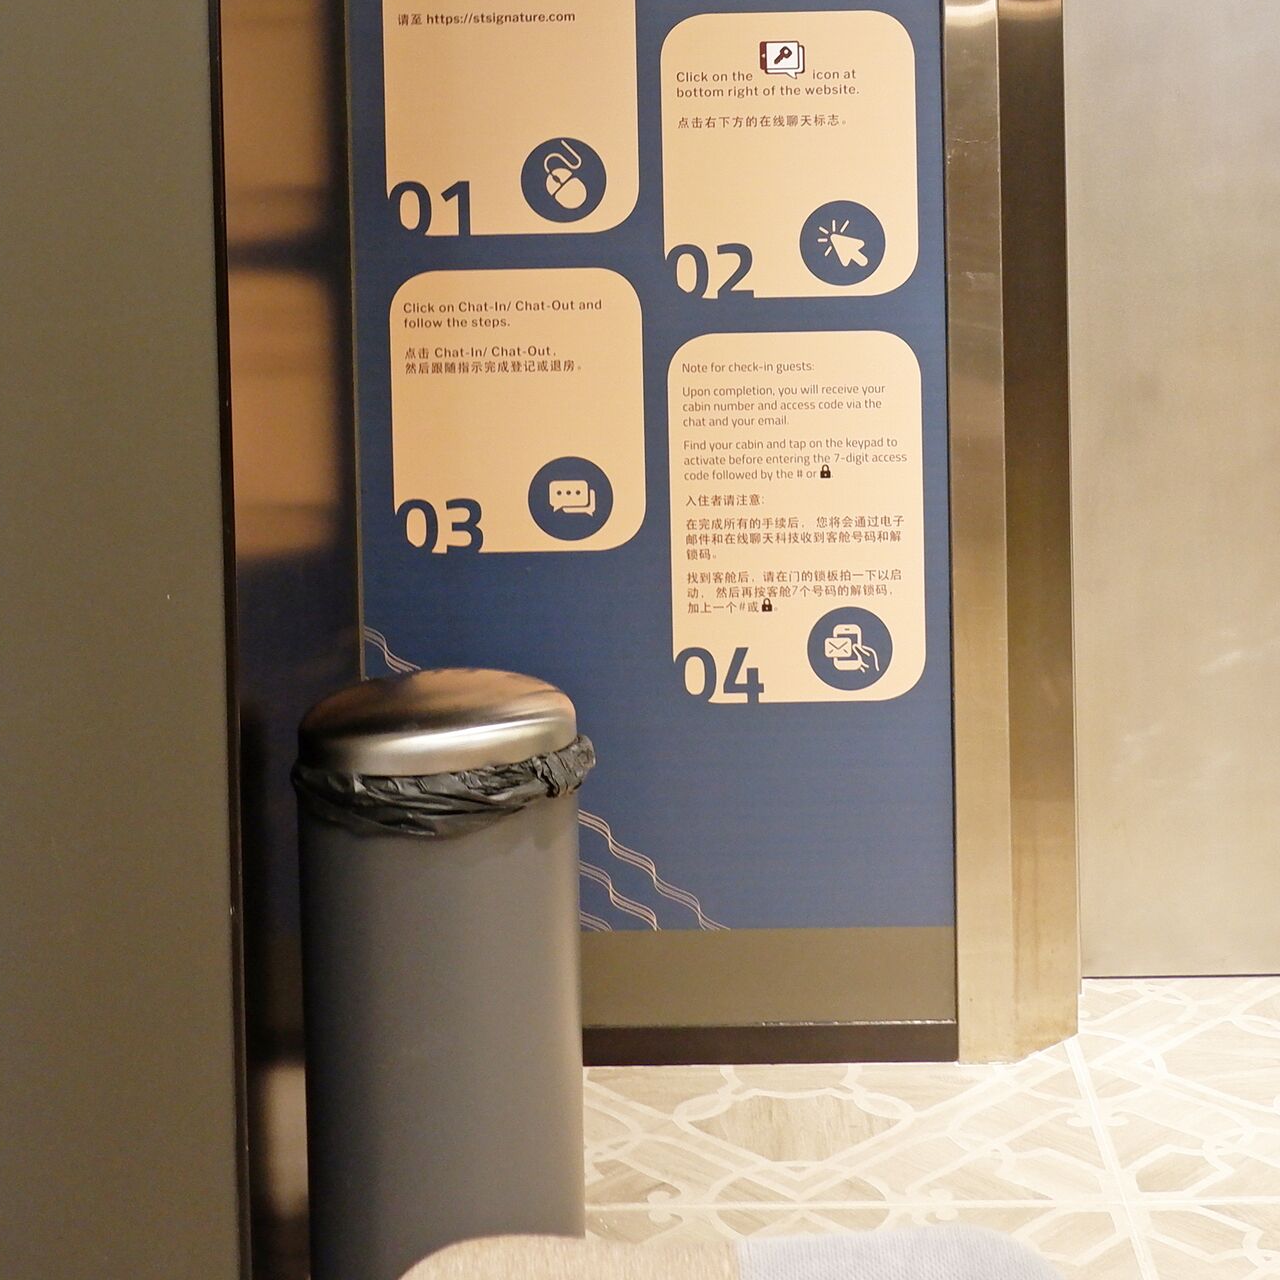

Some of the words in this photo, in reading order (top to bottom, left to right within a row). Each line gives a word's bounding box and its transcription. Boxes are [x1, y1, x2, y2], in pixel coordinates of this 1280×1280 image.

[426, 12, 575, 26] https://stsignature.com
[676, 71, 708, 83] Click
[712, 71, 728, 82] on
[732, 71, 753, 81] the
[812, 69, 839, 80] icon
[843, 69, 856, 80] at
[676, 86, 724, 98] bottom
[728, 86, 759, 98] right
[762, 85, 776, 96] of
[780, 85, 801, 96] the
[804, 84, 860, 96] website.
[388, 180, 471, 236] 01
[666, 243, 754, 299] 02
[403, 302, 435, 314] Click
[439, 302, 455, 313] on
[458, 301, 511, 312] Chat-In/
[515, 300, 575, 312] Chat-Out
[578, 299, 602, 311] and
[403, 317, 443, 329] follow
[447, 317, 467, 328] the
[471, 317, 510, 329] steps.
[434, 346, 488, 358] Chat-In/
[682, 362, 708, 373] Note
[710, 362, 725, 373] for
[728, 361, 774, 372] check-in
[776, 361, 815, 374] guests:
[682, 386, 710, 398] Upon
[713, 385, 776, 398] completion,
[778, 386, 798, 398] you
[800, 384, 819, 394] will
[821, 384, 859, 394] receive
[862, 385, 885, 396] your
[682, 400, 711, 412] cabin
[713, 400, 755, 411] number
[757, 400, 778, 411] and
[780, 401, 816, 410] access
[818, 399, 844, 410] code
[846, 399, 861, 410] via
[864, 399, 882, 409] the
[682, 416, 706, 427] chat
[709, 416, 729, 427] and
[731, 417, 755, 428] your
[757, 416, 789, 426] email.
[683, 440, 707, 451] Find
[709, 440, 733, 452] your
[735, 439, 763, 450] cabin
[766, 439, 786, 449] and
[789, 439, 806, 451] tap
[809, 439, 823, 449] on
[825, 438, 843, 448] the
[845, 437, 884, 449] keypad
[886, 437, 898, 448] to
[683, 454, 726, 466] activate
[728, 454, 763, 465] before
[766, 453, 810, 466] entering
[813, 453, 831, 463] the
[834, 452, 869, 464] 7-digit
[871, 453, 908, 463] access
[683, 469, 709, 481] code
[711, 469, 758, 480] followed
[760, 469, 774, 482] by
[776, 469, 794, 479] the
[806, 469, 817, 479] or
[396, 498, 483, 554] 03
[675, 646, 765, 704] 04
